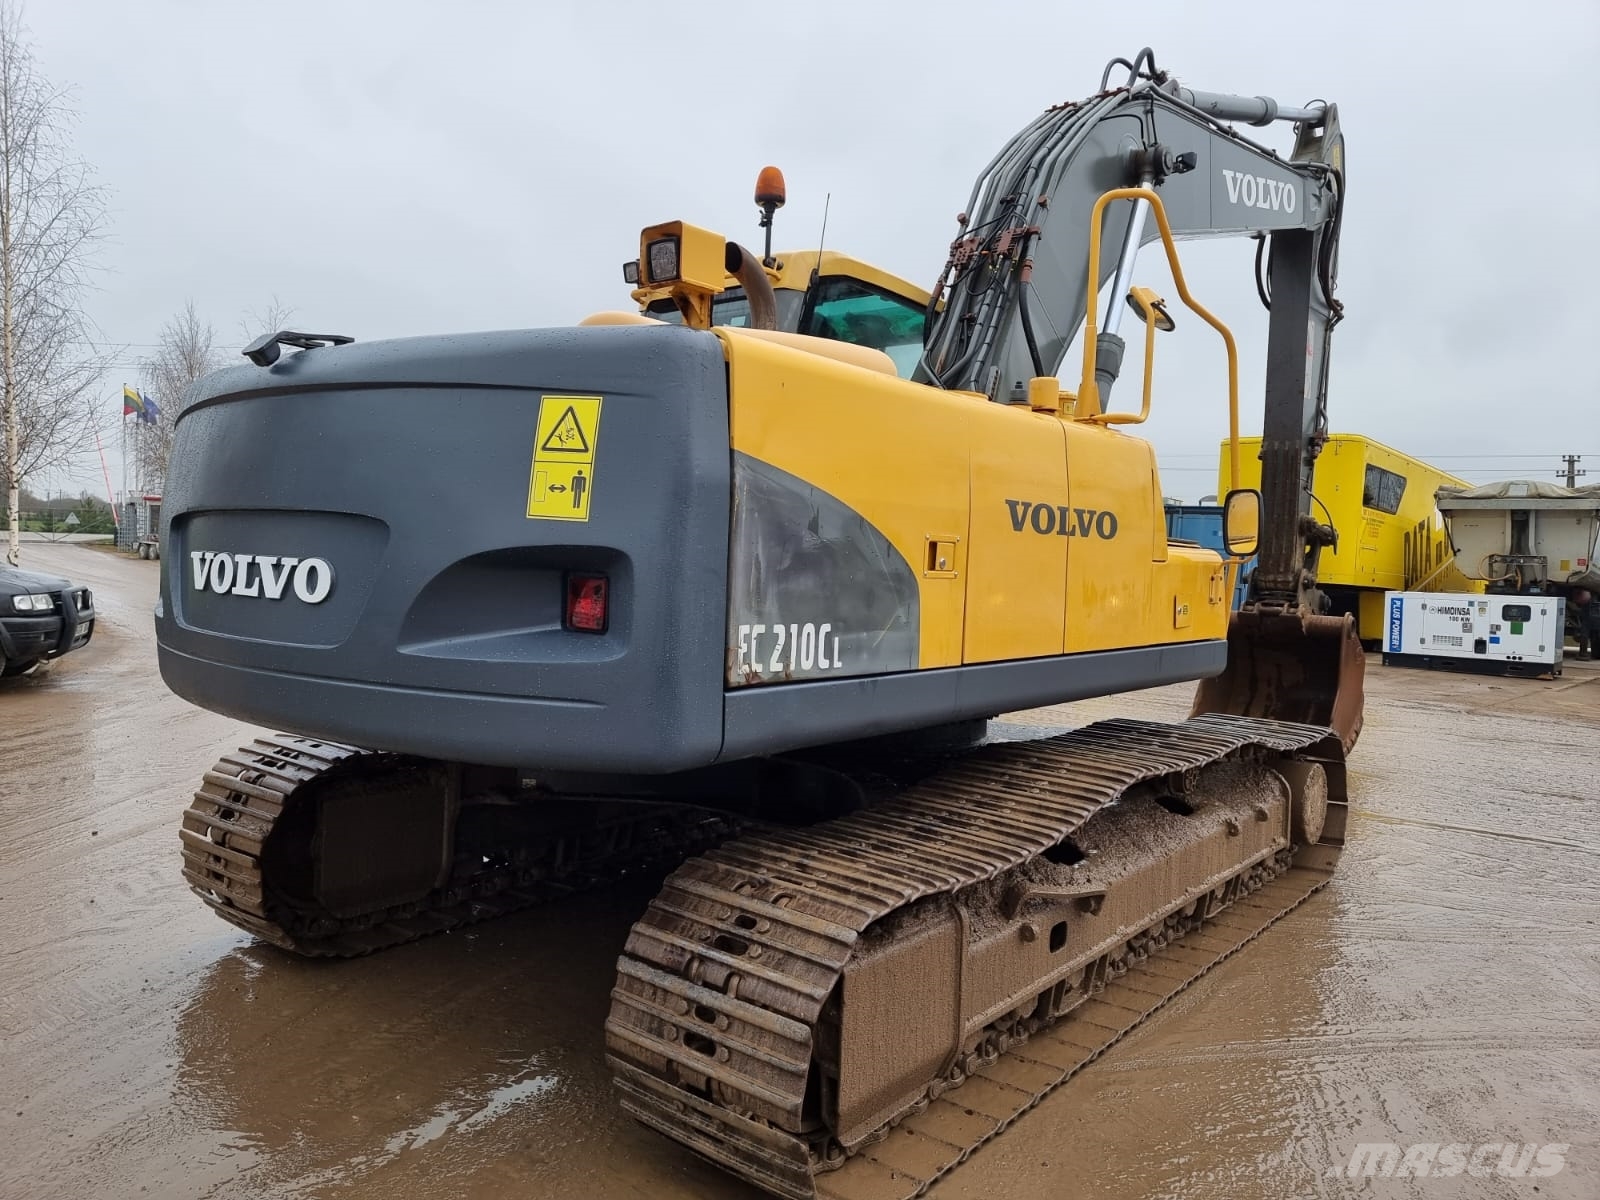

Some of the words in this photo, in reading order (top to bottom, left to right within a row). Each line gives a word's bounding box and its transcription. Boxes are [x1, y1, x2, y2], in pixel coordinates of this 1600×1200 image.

[1222, 169, 1296, 214] VOLVO
[1004, 498, 1119, 540] VOLVO
[190, 551, 334, 605] VOLVO
[1391, 599, 1401, 618] PLUS
[1437, 606, 1471, 616] HIMOINSA
[737, 624, 766, 674] EC
